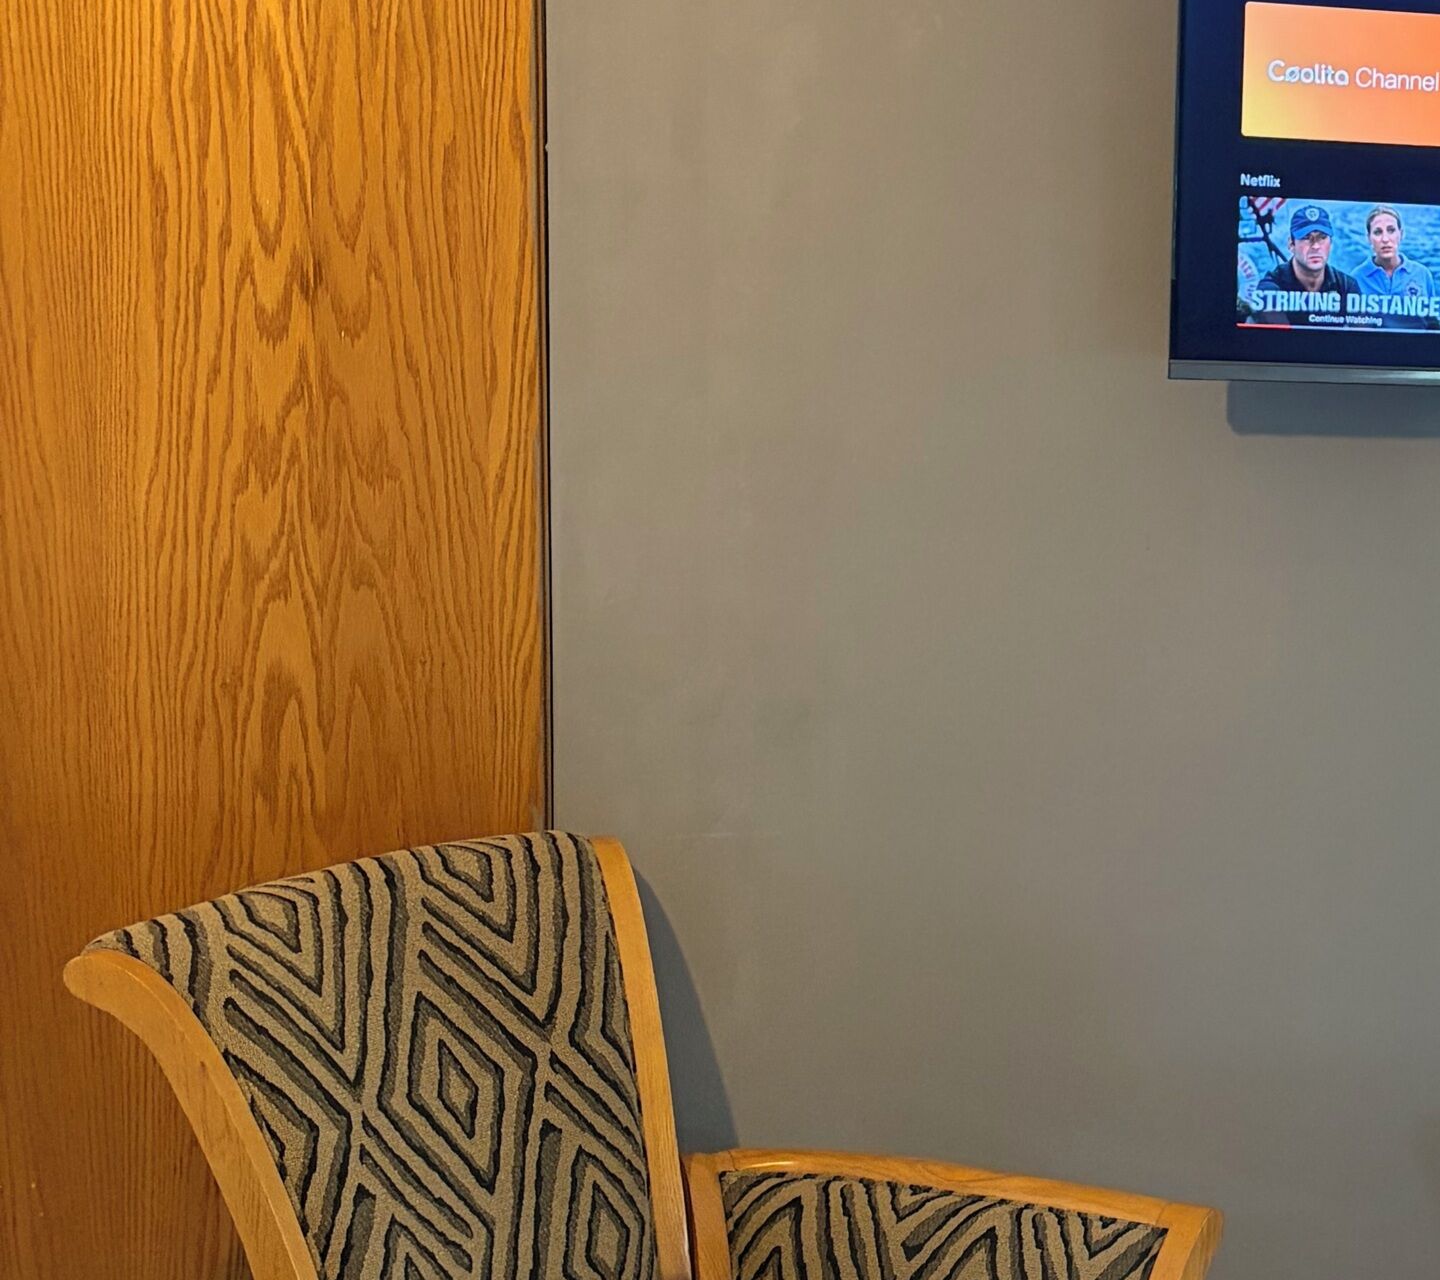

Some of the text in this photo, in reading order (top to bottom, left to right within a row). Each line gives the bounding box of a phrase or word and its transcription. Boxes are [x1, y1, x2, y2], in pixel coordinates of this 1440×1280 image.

[1355, 67, 1440, 92] Channel
[1240, 173, 1281, 189] Netflix
[1251, 289, 1440, 317] STRIKING DISTANCE
[1308, 313, 1383, 326] Continue Watching
